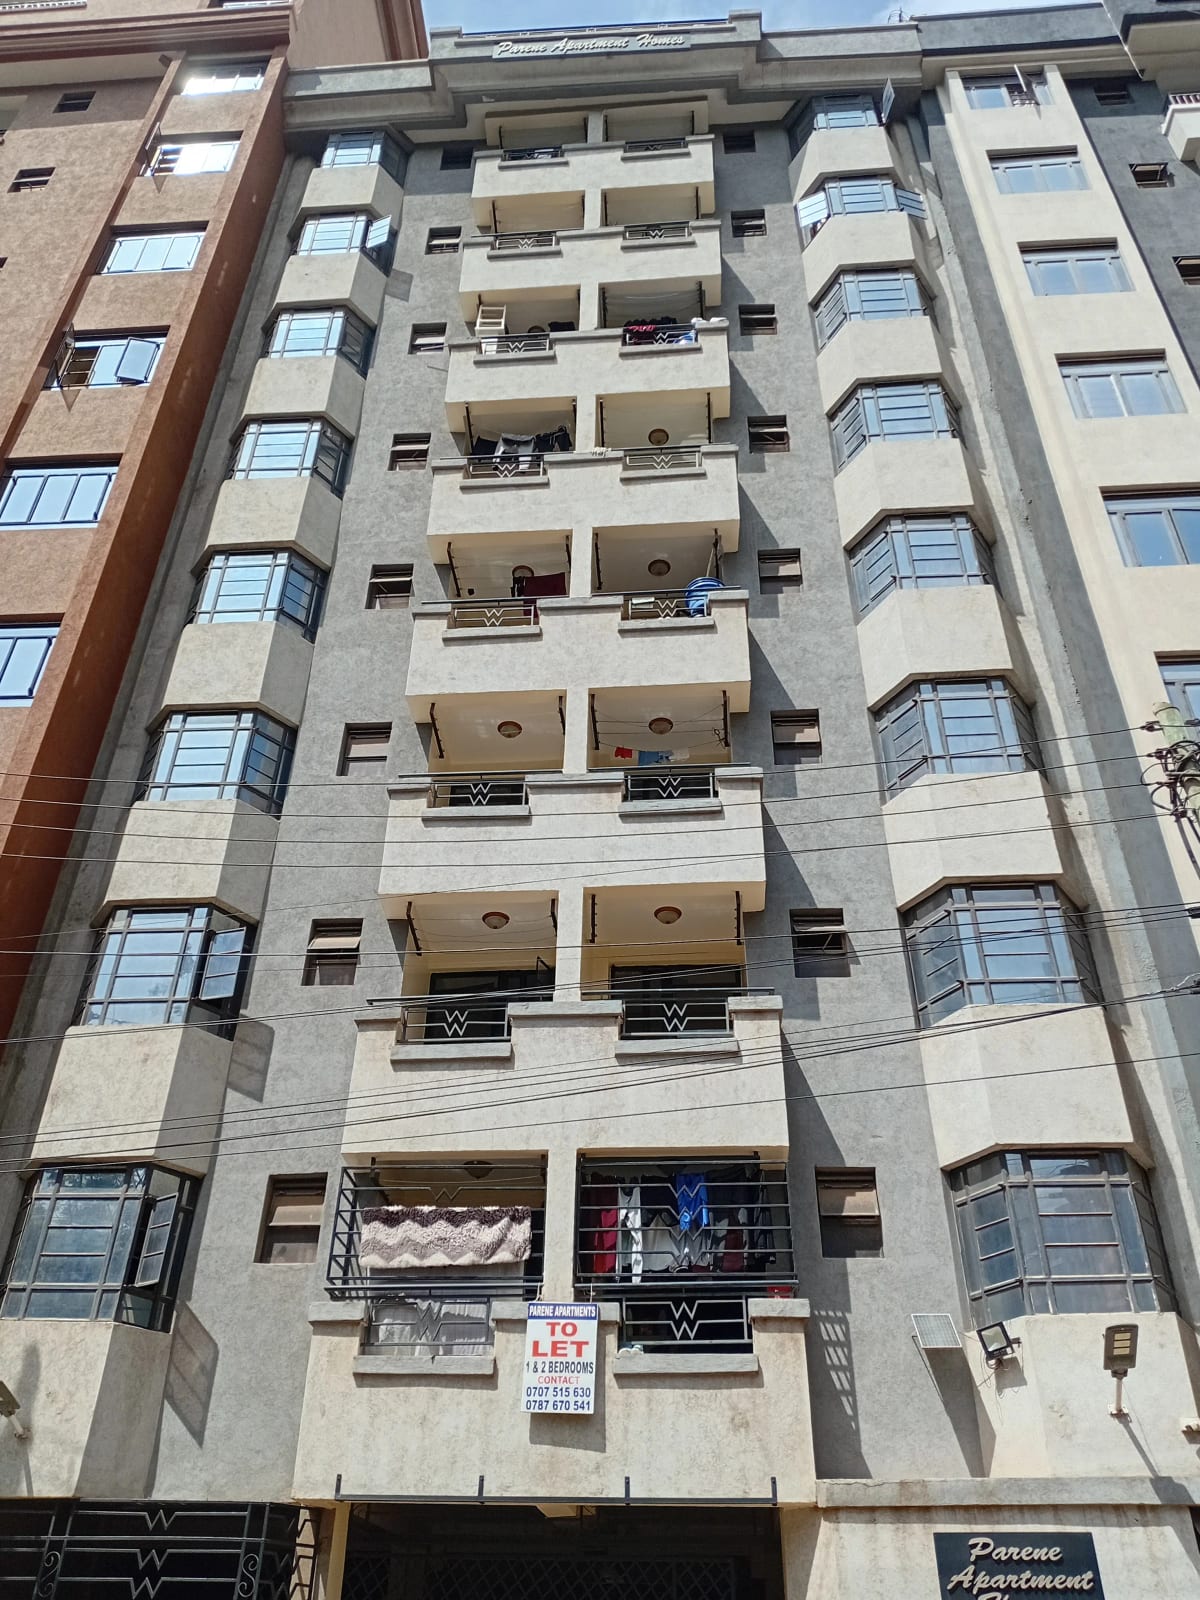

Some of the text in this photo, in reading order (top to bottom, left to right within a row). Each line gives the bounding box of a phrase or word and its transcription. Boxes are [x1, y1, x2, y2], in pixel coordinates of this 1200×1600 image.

[550, 37, 629, 55] Apartment
[636, 33, 685, 48] Homes
[529, 1305, 596, 1317] PARENE APARTMENTS
[546, 1321, 578, 1337] TO
[532, 1340, 589, 1358] LET
[533, 1361, 538, 1373] &
[541, 1361, 546, 1373] 2
[548, 1361, 594, 1374] BEDROOMS
[538, 1375, 580, 1385] CONTACT
[526, 1386, 591, 1398] 0707 515 630
[526, 1399, 590, 1411] 0787 670 541
[968, 1537, 1063, 1562] Parene
[947, 1564, 1095, 1595] Apartment
